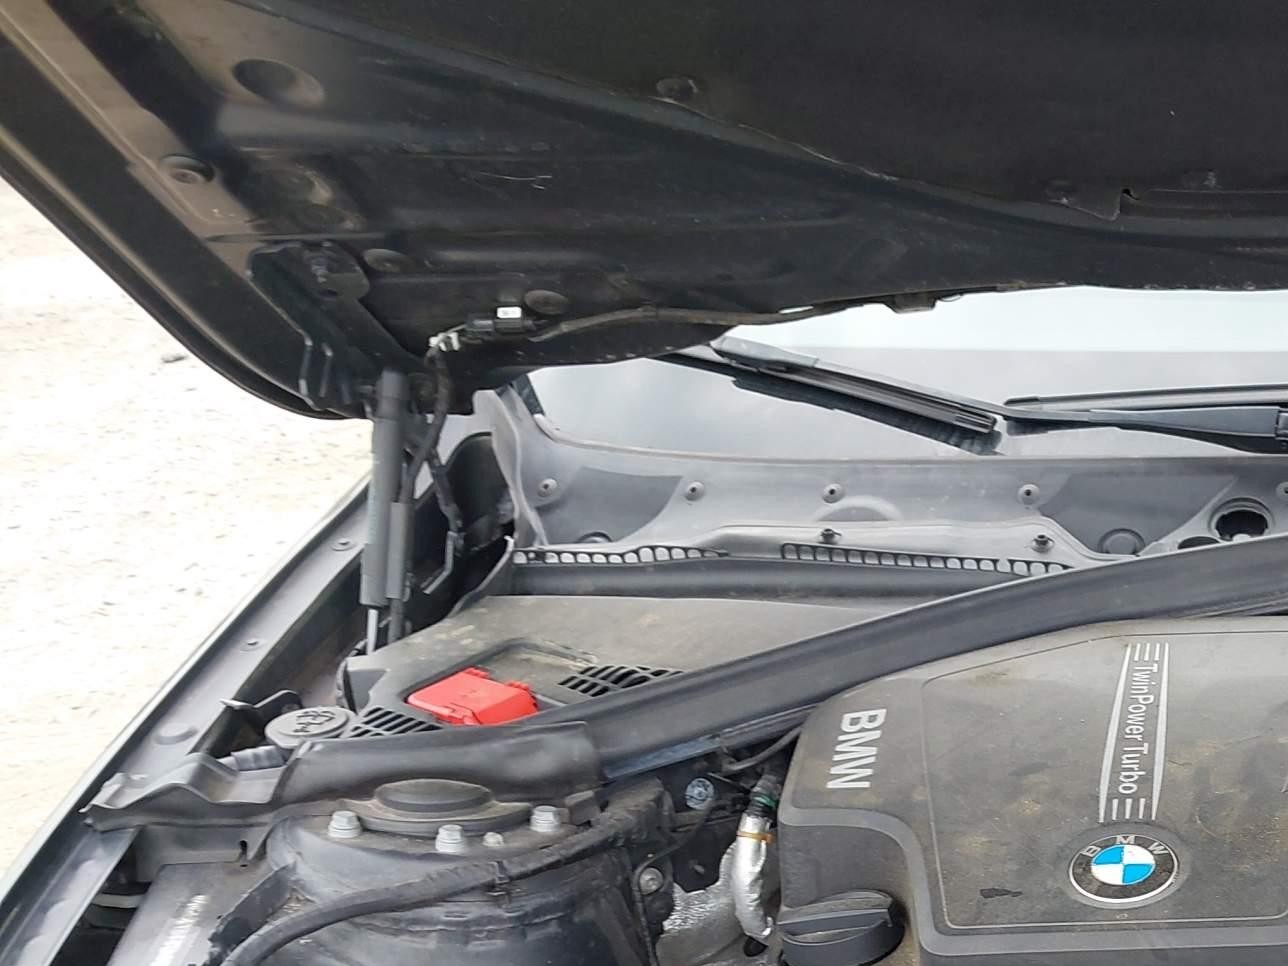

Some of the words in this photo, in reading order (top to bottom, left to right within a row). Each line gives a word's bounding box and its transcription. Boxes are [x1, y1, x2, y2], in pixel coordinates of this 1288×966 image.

[1123, 663, 1158, 741] TwinPower
[826, 708, 887, 789] BMW
[1118, 742, 1149, 795] Turbo
[1080, 835, 1169, 857] BMW
